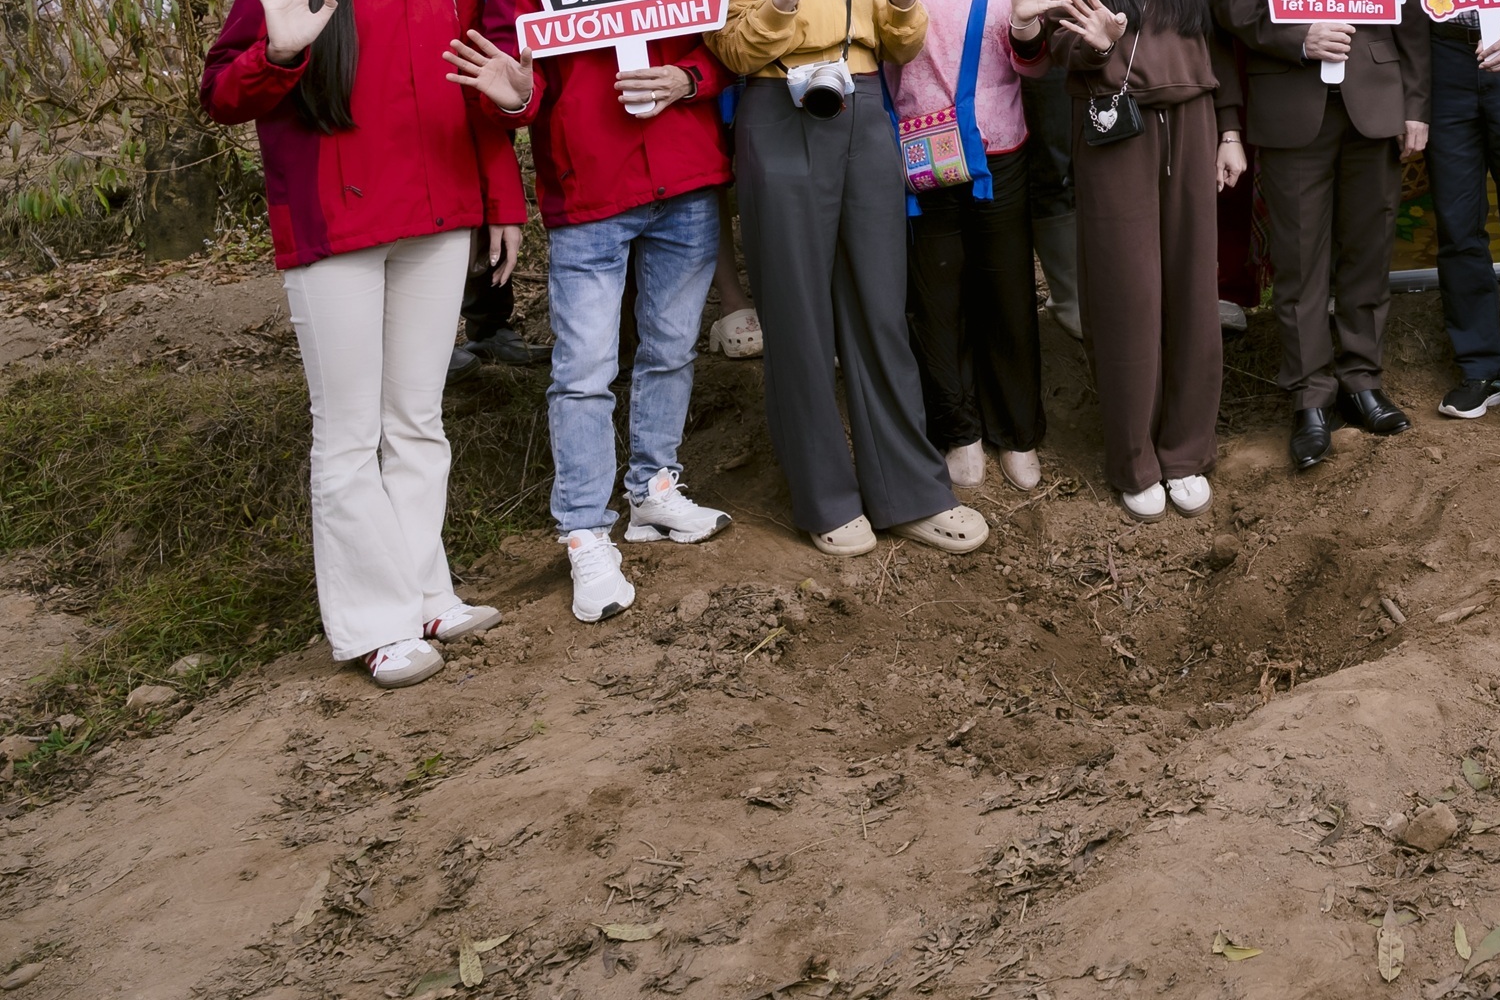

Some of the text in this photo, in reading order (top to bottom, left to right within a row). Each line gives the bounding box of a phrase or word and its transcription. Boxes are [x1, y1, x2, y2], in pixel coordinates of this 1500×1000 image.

[1306, 0, 1323, 12] Ta
[1326, 0, 1345, 13] Ba
[1348, 0, 1383, 14] Miền
[531, 10, 625, 46] VƯƠN
